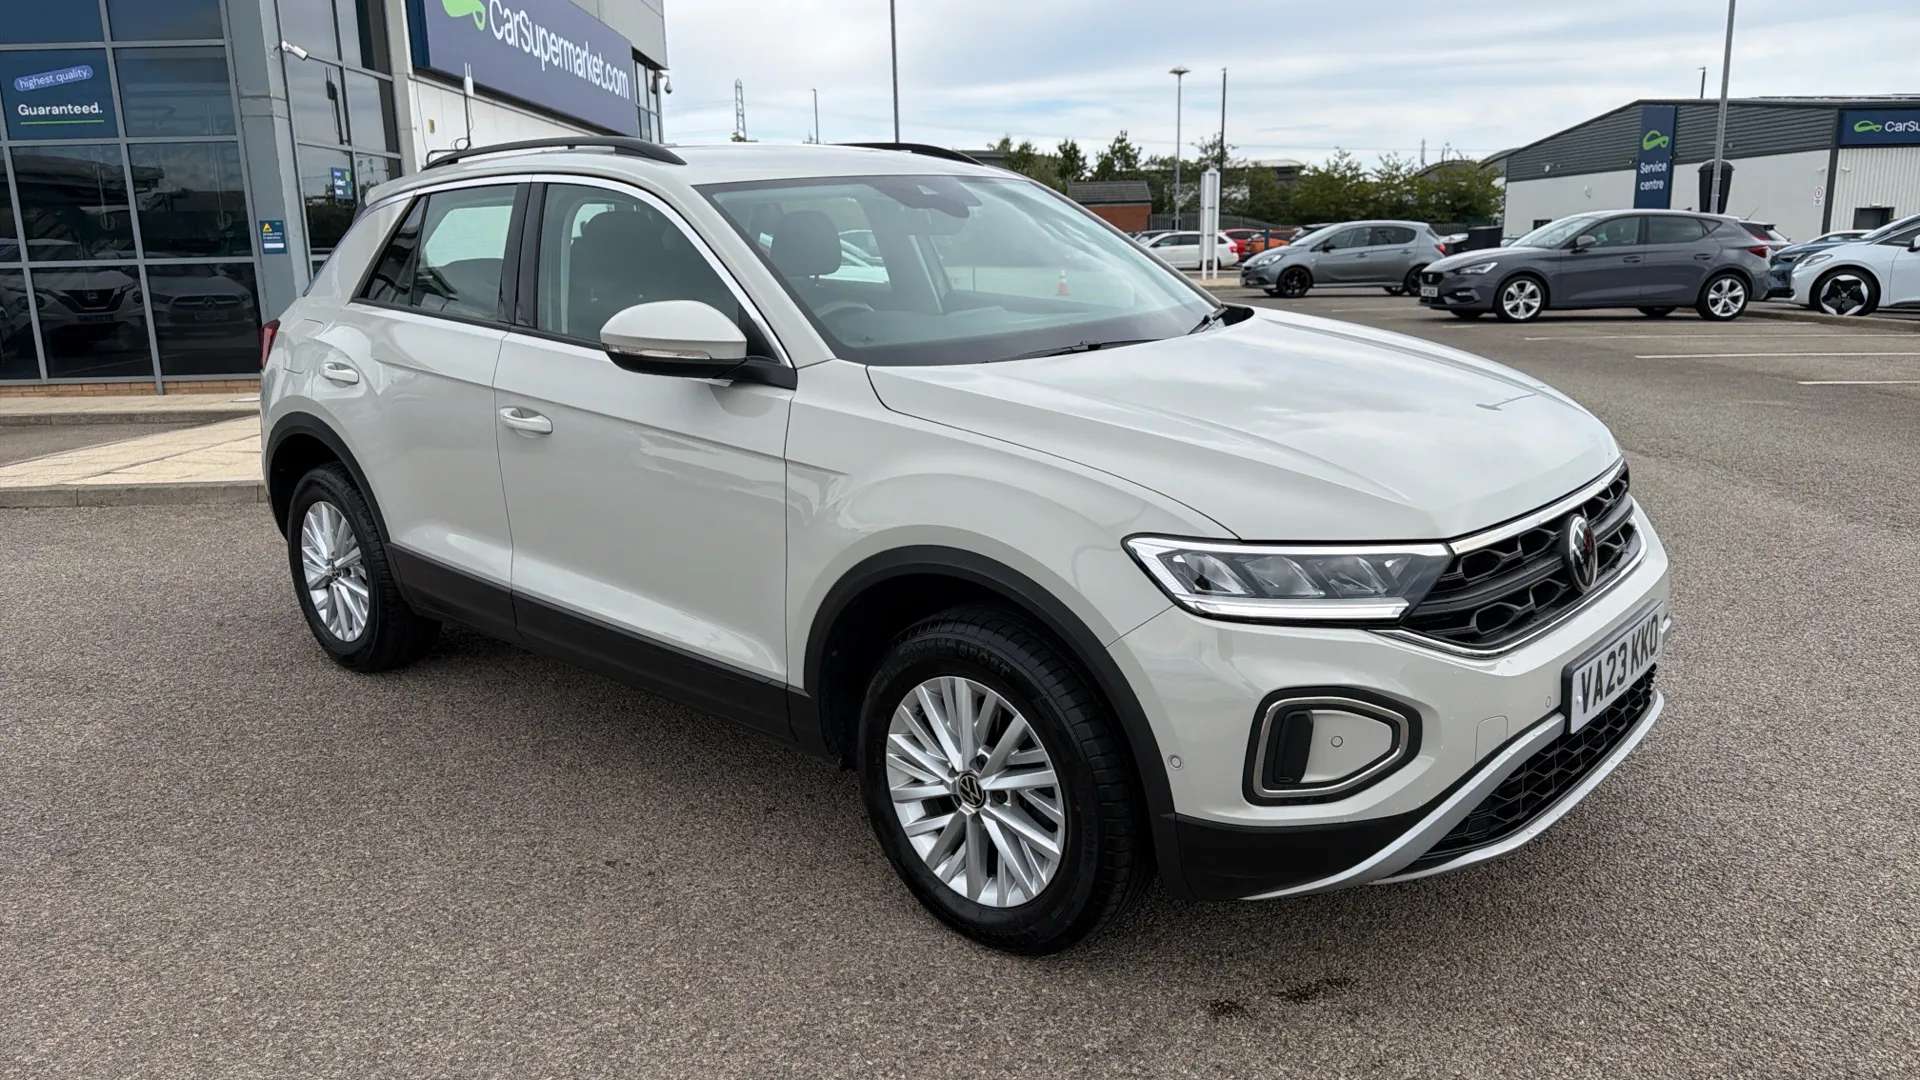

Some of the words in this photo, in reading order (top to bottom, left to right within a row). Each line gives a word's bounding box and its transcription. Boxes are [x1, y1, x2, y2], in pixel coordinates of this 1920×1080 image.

[489, 0, 630, 100] CarSupermarket.com
[19, 75, 55, 90] highest
[17, 101, 104, 116] Guaranteed.
[1639, 160, 1668, 174] Service
[1639, 178, 1665, 191] centre
[1581, 642, 1628, 714] VA23
